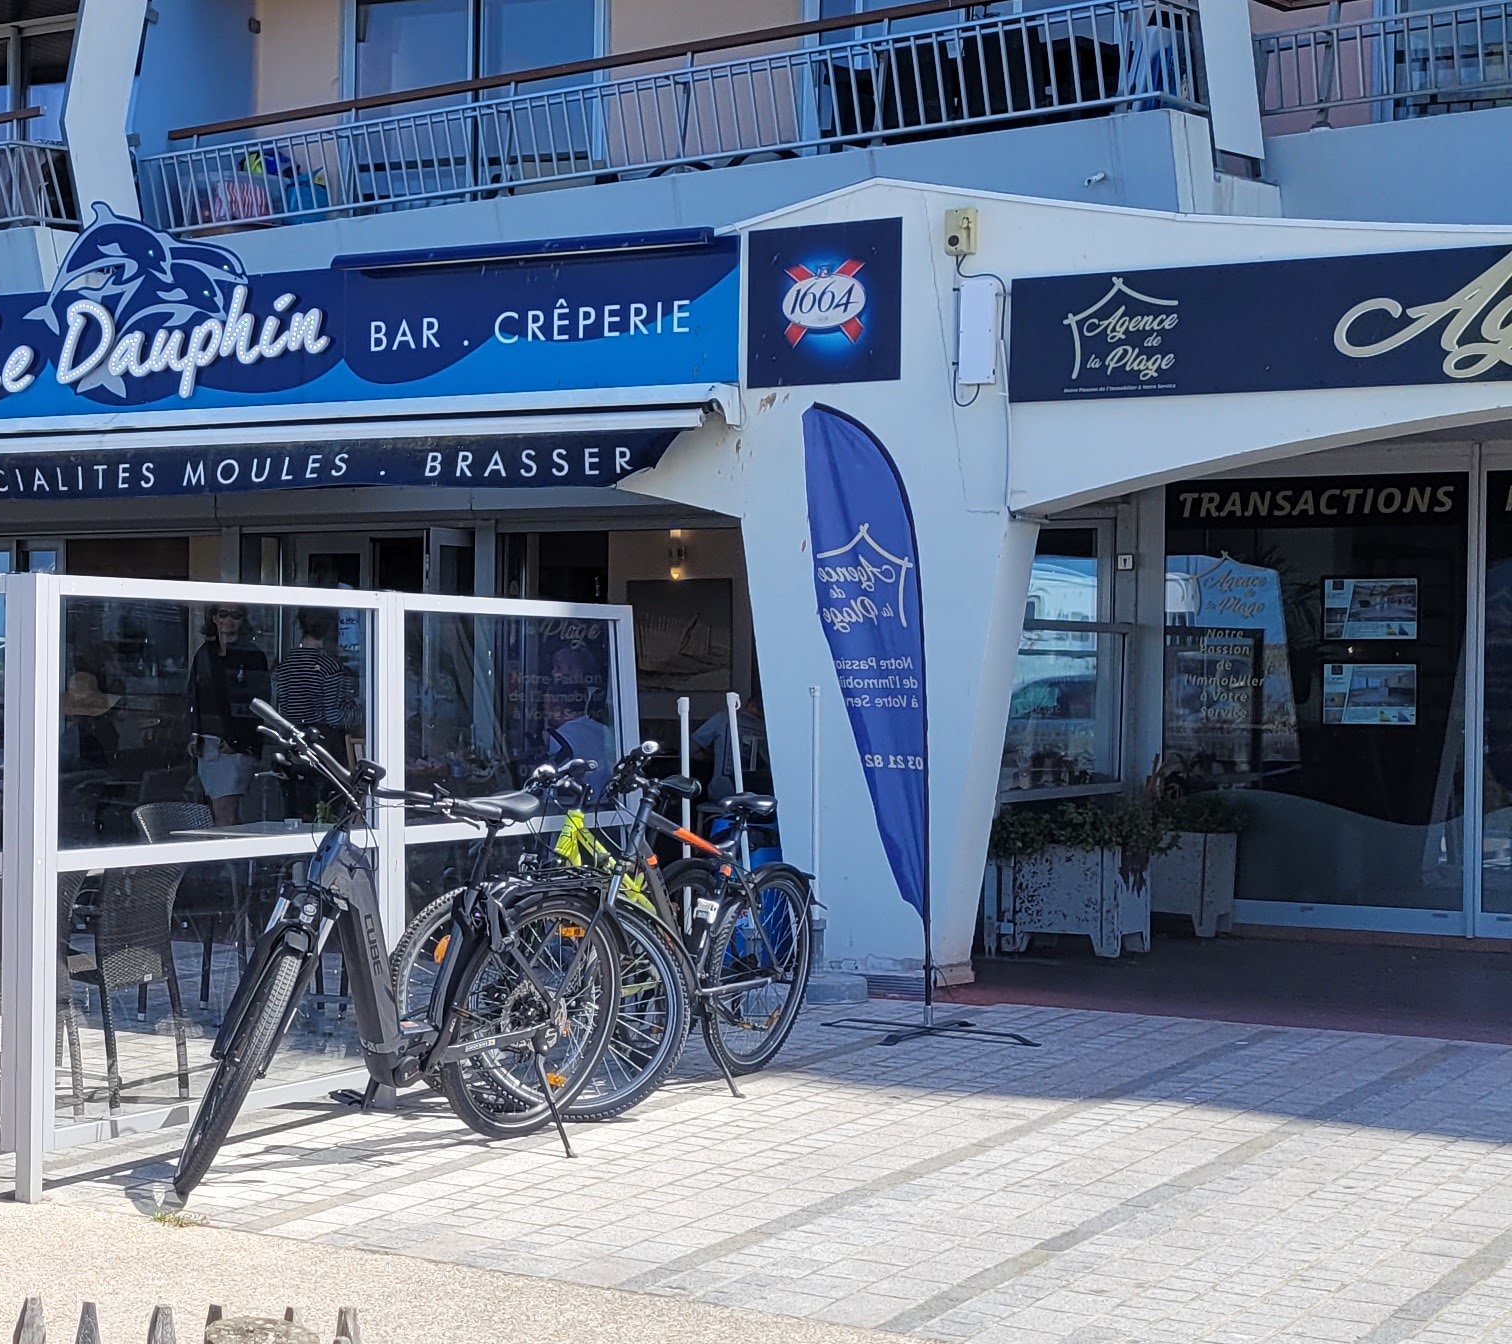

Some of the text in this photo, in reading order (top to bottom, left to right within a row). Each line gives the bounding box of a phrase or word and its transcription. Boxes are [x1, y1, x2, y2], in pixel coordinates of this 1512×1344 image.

[790, 279, 859, 315] 1664
[370, 298, 691, 352] BAR CRÊPERIE
[1083, 304, 1179, 343] Agence
[1144, 332, 1162, 347] de
[56, 285, 330, 399] Dauphin
[1086, 345, 1176, 381] la Plage
[182, 453, 349, 487] MOULES
[1178, 485, 1456, 518] TRANSACTIONS
[1200, 644, 1250, 656] Passion
[1206, 629, 1244, 639] Notre
[1216, 660, 1232, 671] de
[1200, 706, 1249, 719] Service
[1212, 690, 1249, 703] Votre
[363, 913, 383, 977] CUBE
